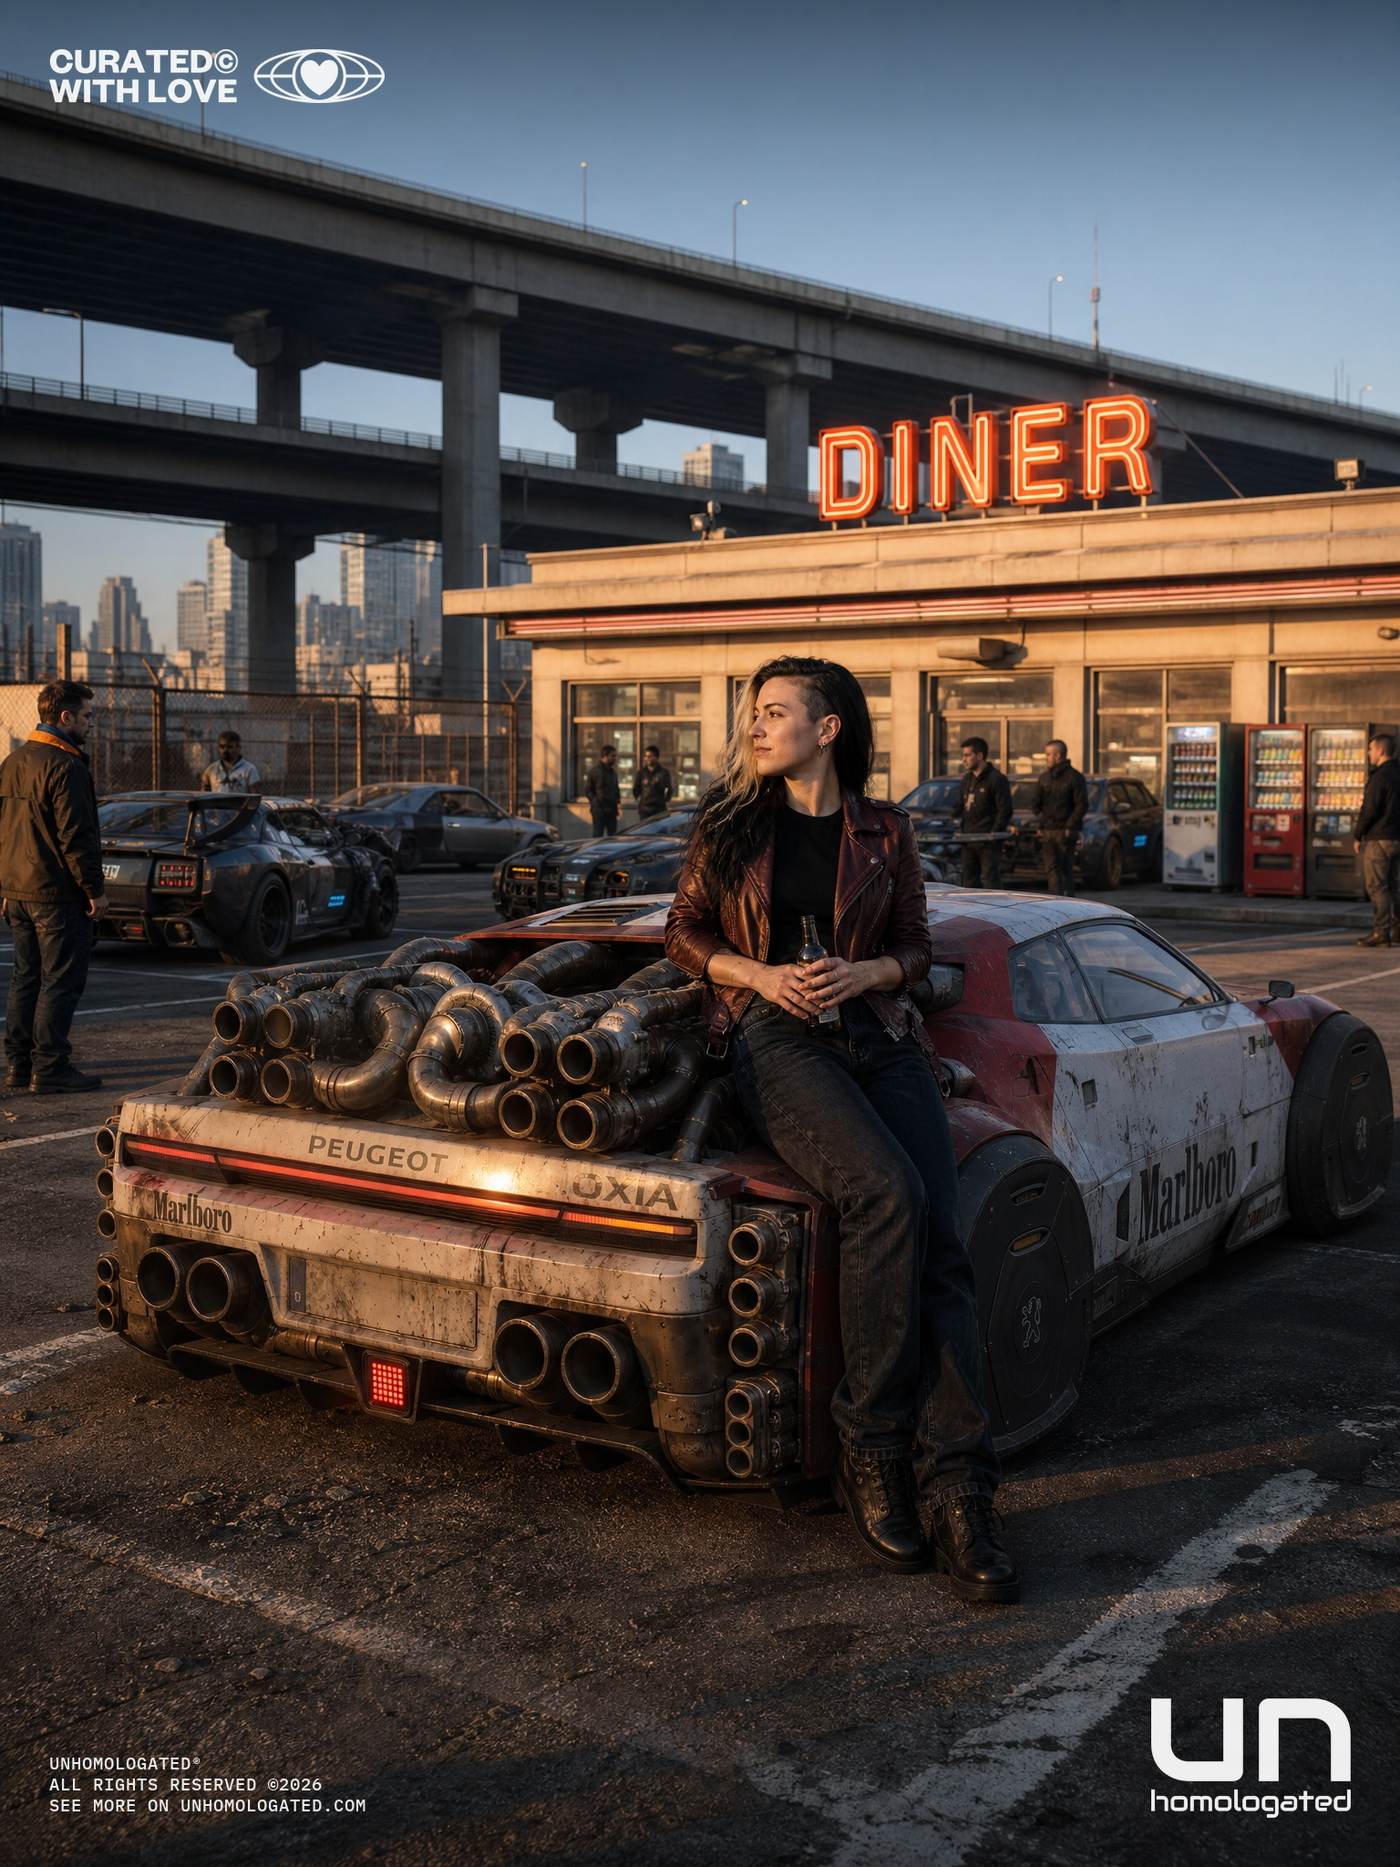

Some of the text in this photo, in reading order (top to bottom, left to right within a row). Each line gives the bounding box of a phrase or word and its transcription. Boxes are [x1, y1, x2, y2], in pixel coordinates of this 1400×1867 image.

[819, 394, 1153, 521] DINER
[308, 1135, 449, 1174] PEUGEOT
[153, 1190, 232, 1233] Marlboro
[572, 1171, 679, 1212] OXIA
[1137, 1143, 1236, 1246] Marlboro
